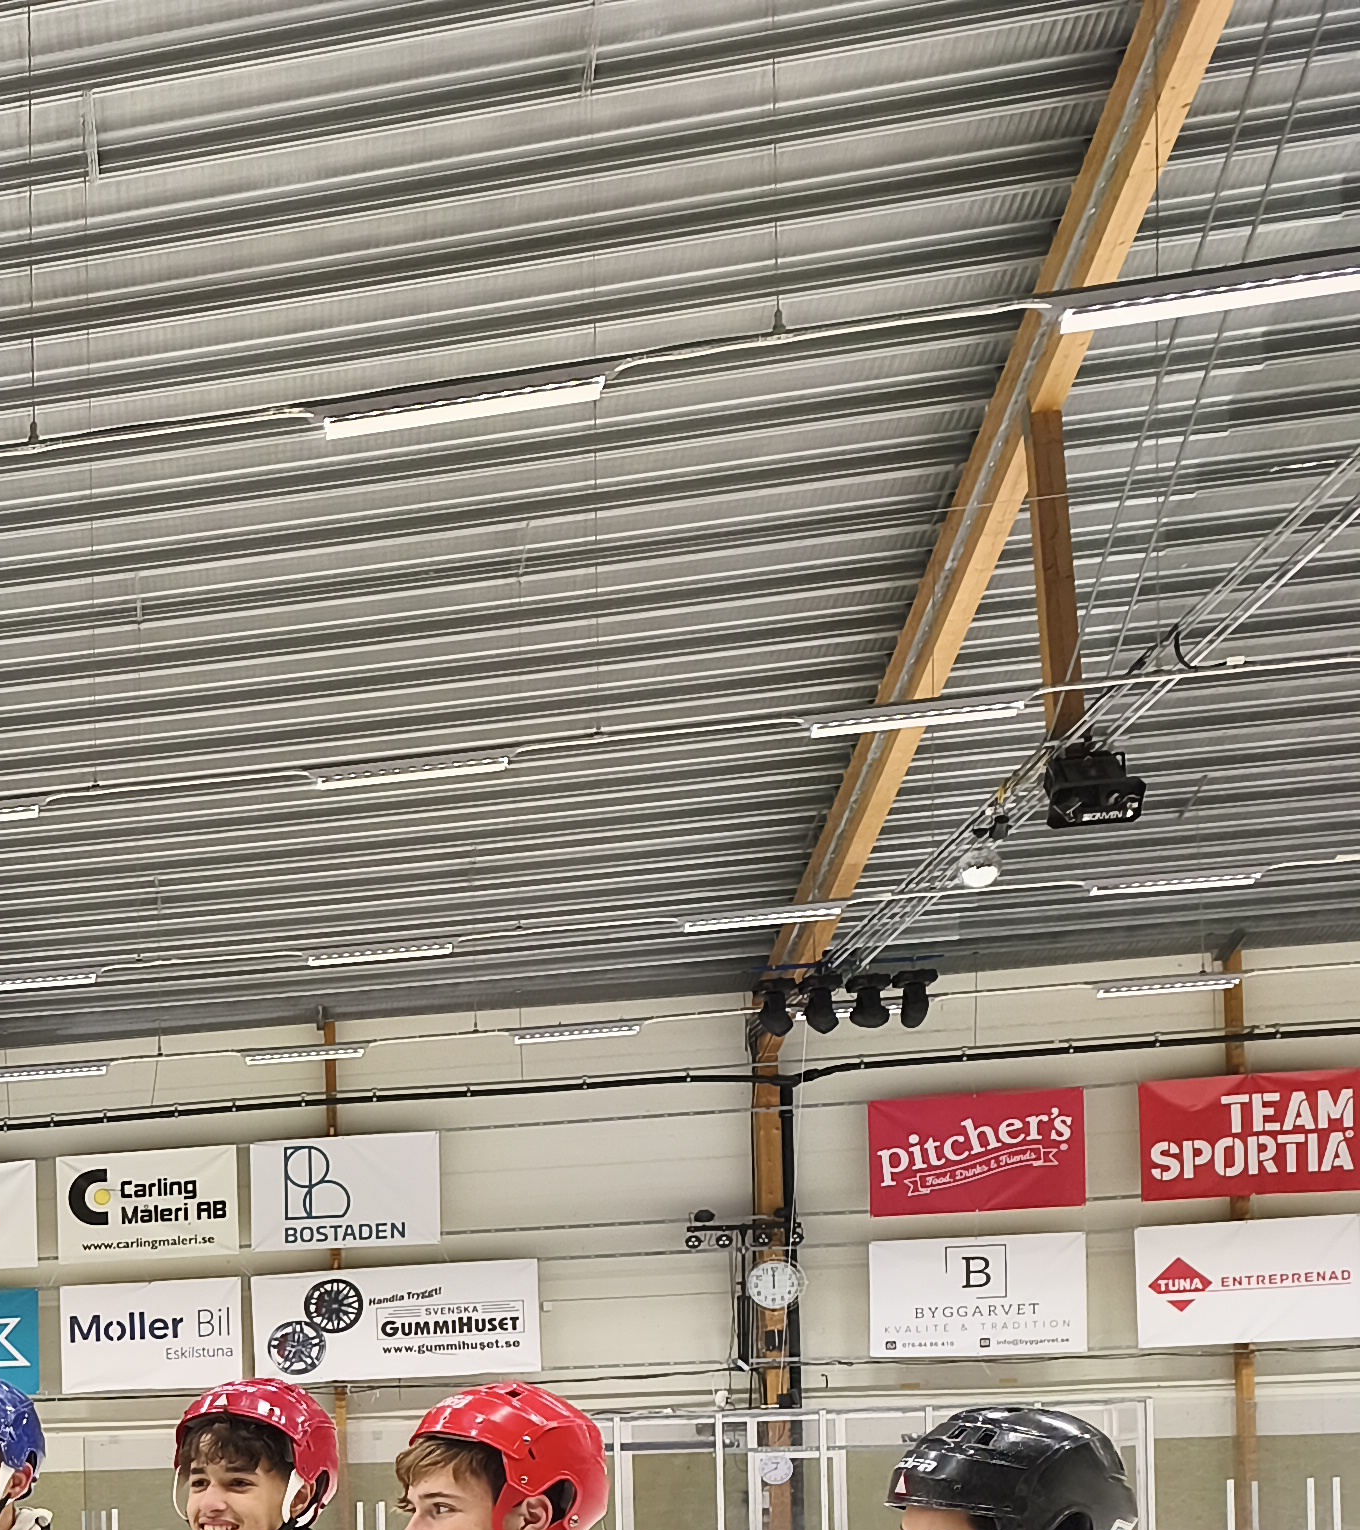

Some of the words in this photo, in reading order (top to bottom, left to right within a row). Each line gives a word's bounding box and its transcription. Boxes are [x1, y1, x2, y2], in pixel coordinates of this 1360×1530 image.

[1220, 1088, 1354, 1134] TEAM
[877, 1107, 1073, 1187] pitcher's
[1150, 1131, 1355, 1181] SPORTIA
[955, 1163, 989, 1180] Drinks
[999, 1151, 1038, 1166] Friends
[120, 1177, 197, 1200] Carling
[121, 1202, 189, 1225] Måleri
[196, 1200, 227, 1220] AB
[81, 1234, 216, 1251] www.carlingmaleri.se
[284, 1222, 407, 1245] BOSTADEN
[961, 1256, 992, 1289] B
[1157, 1276, 1204, 1293] TUNA
[1220, 1268, 1352, 1288] ENTREPRENAD
[368, 1292, 405, 1307] Handla
[406, 1286, 442, 1301] Tryggt!
[197, 1306, 231, 1338] Bil
[425, 1305, 479, 1316] SVENSKA
[914, 1302, 1040, 1319] BYGGARVET
[980, 1318, 1071, 1331] TRADITION
[165, 1346, 234, 1361] Eskilstuna
[382, 1338, 521, 1355] www.gummihuset.se
